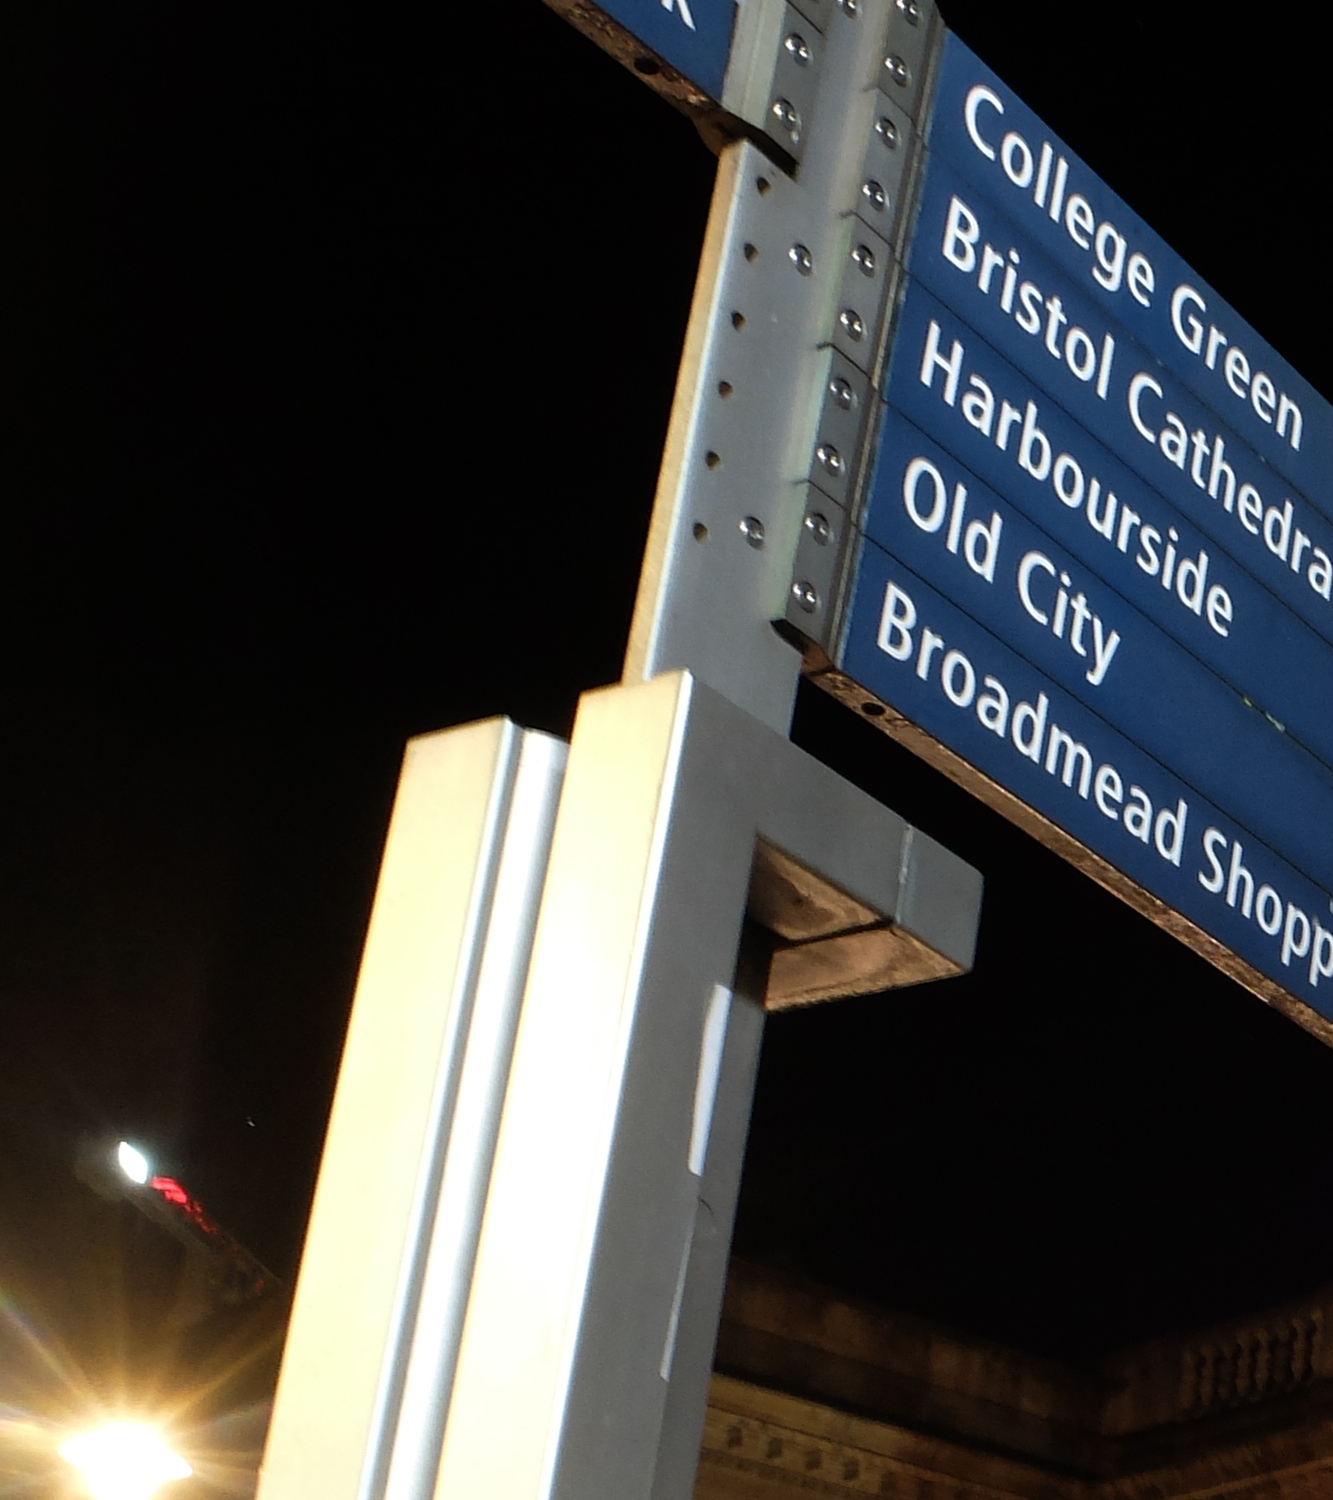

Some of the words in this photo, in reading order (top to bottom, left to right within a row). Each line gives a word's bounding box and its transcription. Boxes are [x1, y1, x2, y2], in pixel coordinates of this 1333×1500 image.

[942, 195, 1114, 401] Bristol
[965, 85, 1155, 308] College
[1171, 284, 1304, 452] Green
[904, 457, 1002, 583] Old
[1018, 550, 1121, 686] City
[919, 319, 1235, 637] Harbourside
[877, 580, 1189, 867] Broadmead
